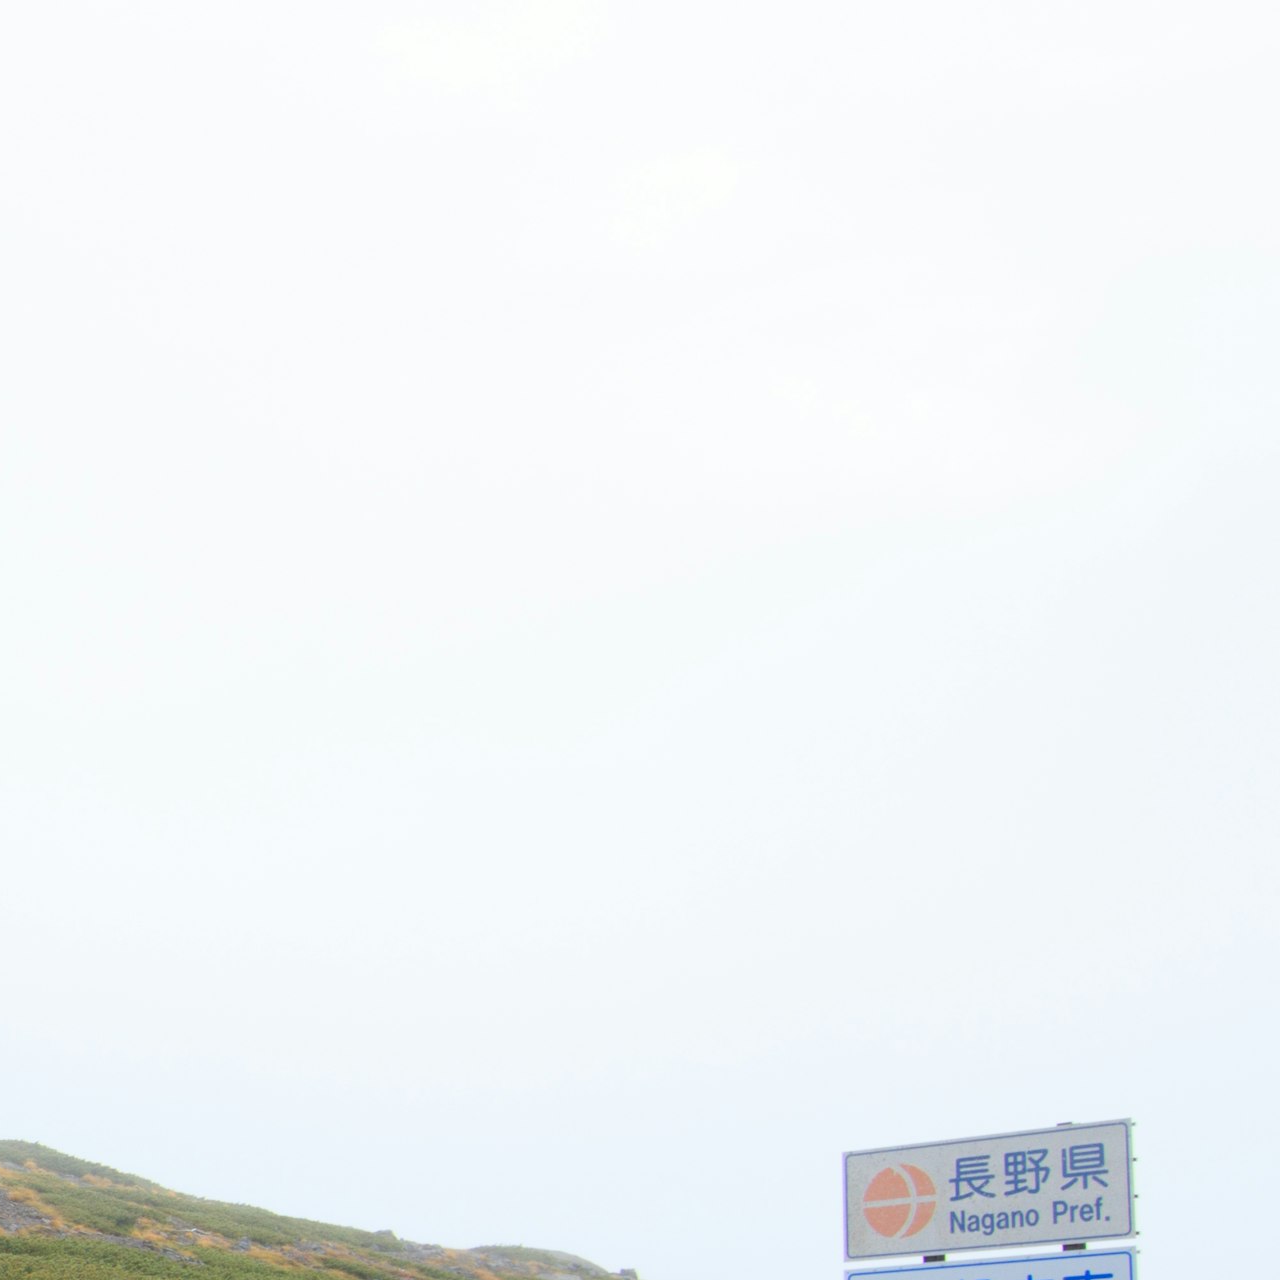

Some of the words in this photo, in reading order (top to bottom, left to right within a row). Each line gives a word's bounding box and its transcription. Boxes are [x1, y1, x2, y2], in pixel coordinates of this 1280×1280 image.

[948, 1143, 1109, 1201] 長野県
[949, 1209, 1040, 1236] Nagano
[1052, 1197, 1111, 1225] Pref.
